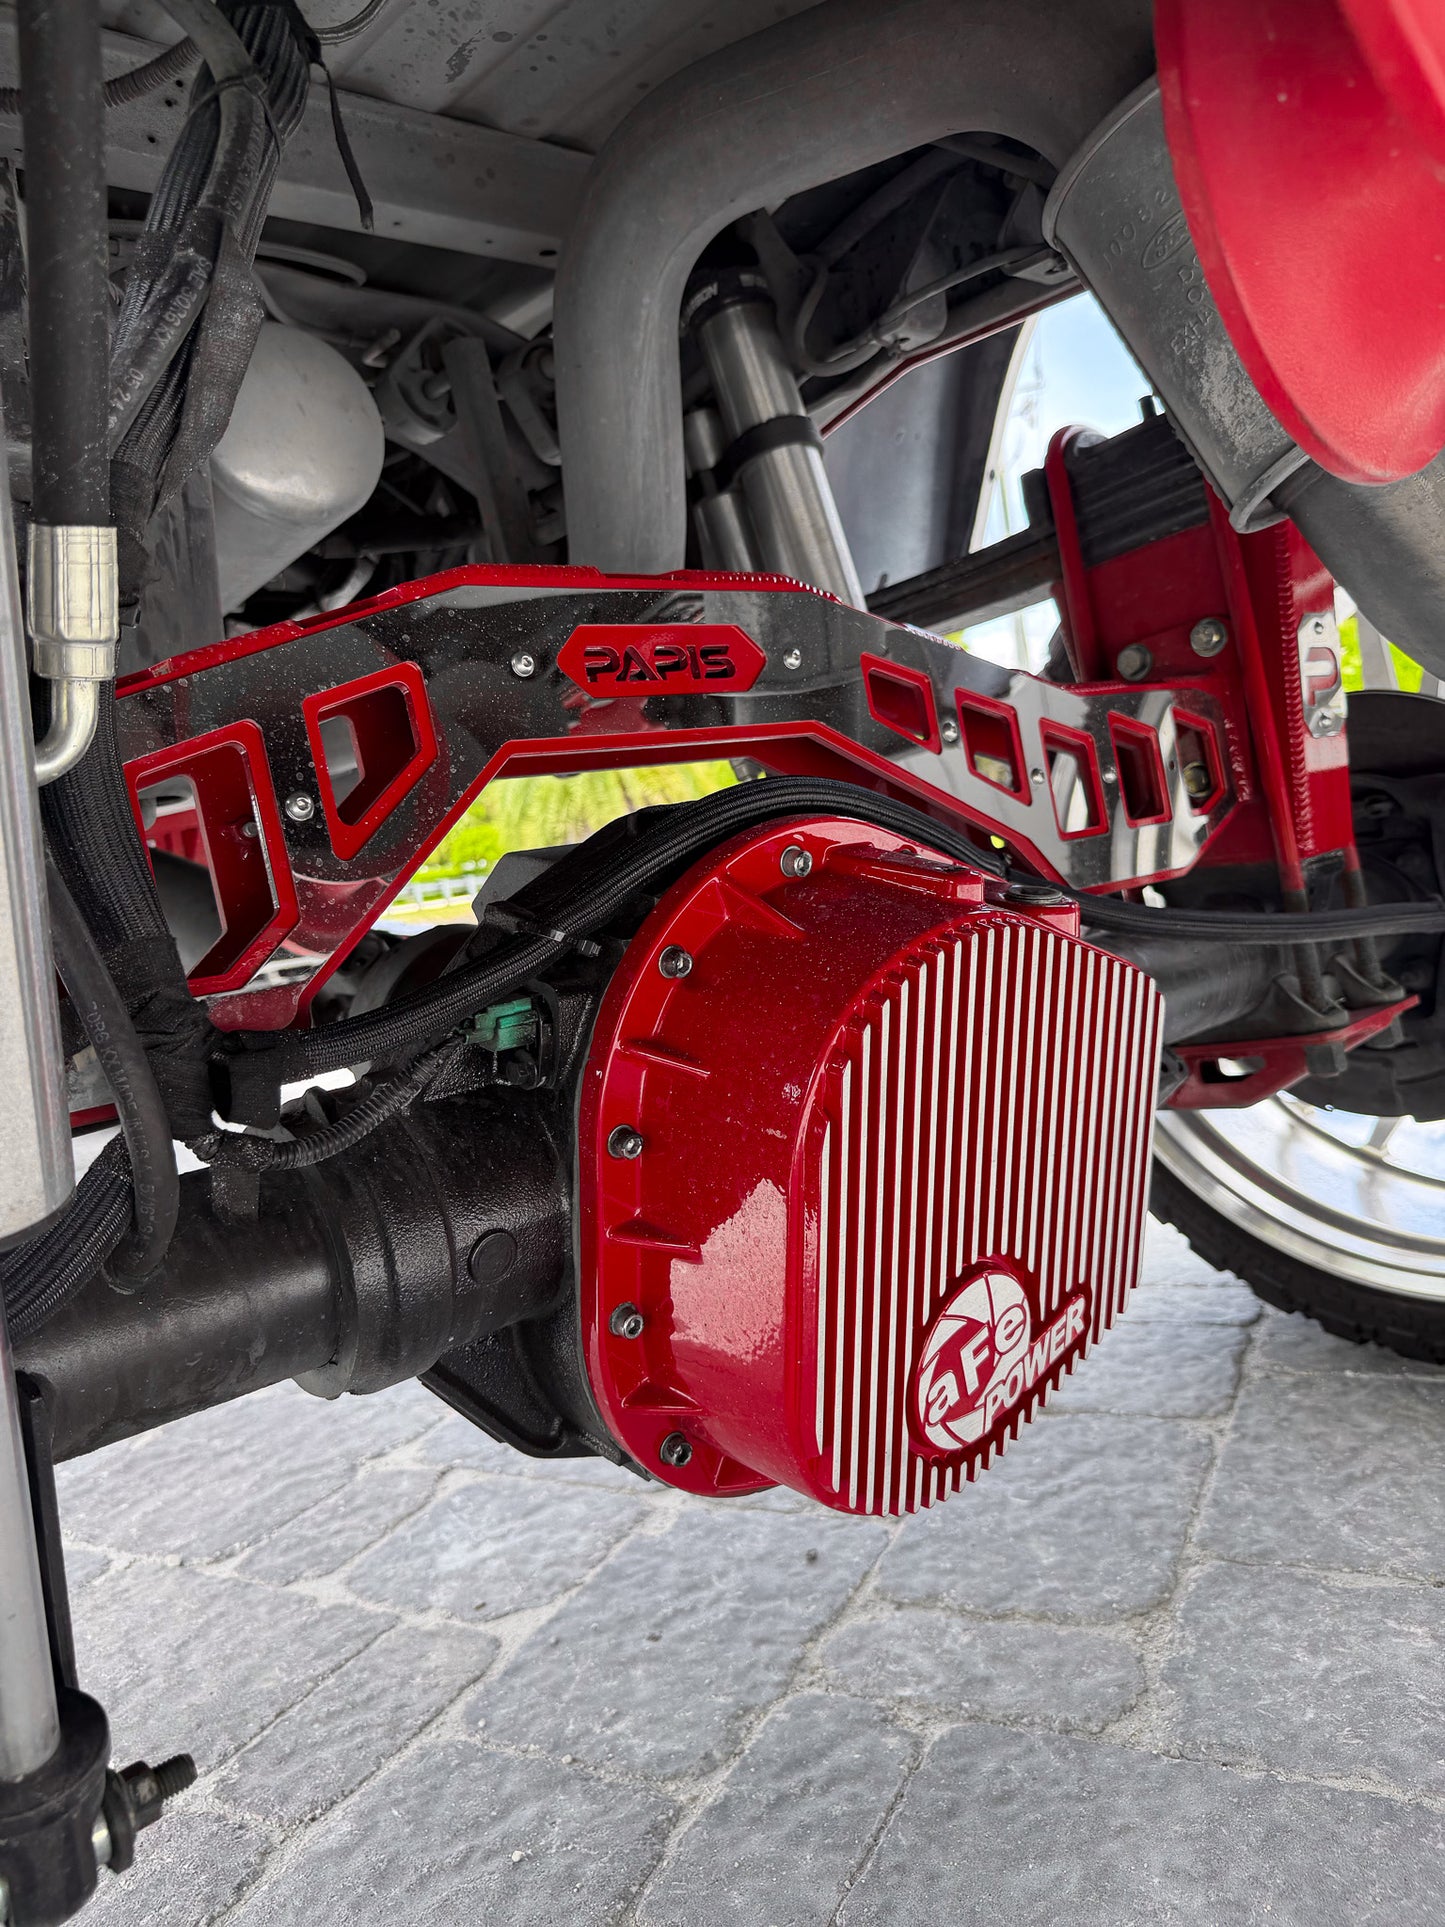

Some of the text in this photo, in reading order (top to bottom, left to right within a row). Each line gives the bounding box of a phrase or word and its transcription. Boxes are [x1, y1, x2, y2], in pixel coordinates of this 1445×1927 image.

[187, 256, 213, 290] SAE
[163, 285, 197, 327] 30R6
[150, 324, 176, 349] KX
[584, 645, 737, 682] PAPIS
[927, 1305, 1026, 1425] aFe
[983, 1295, 1086, 1433] POWER
